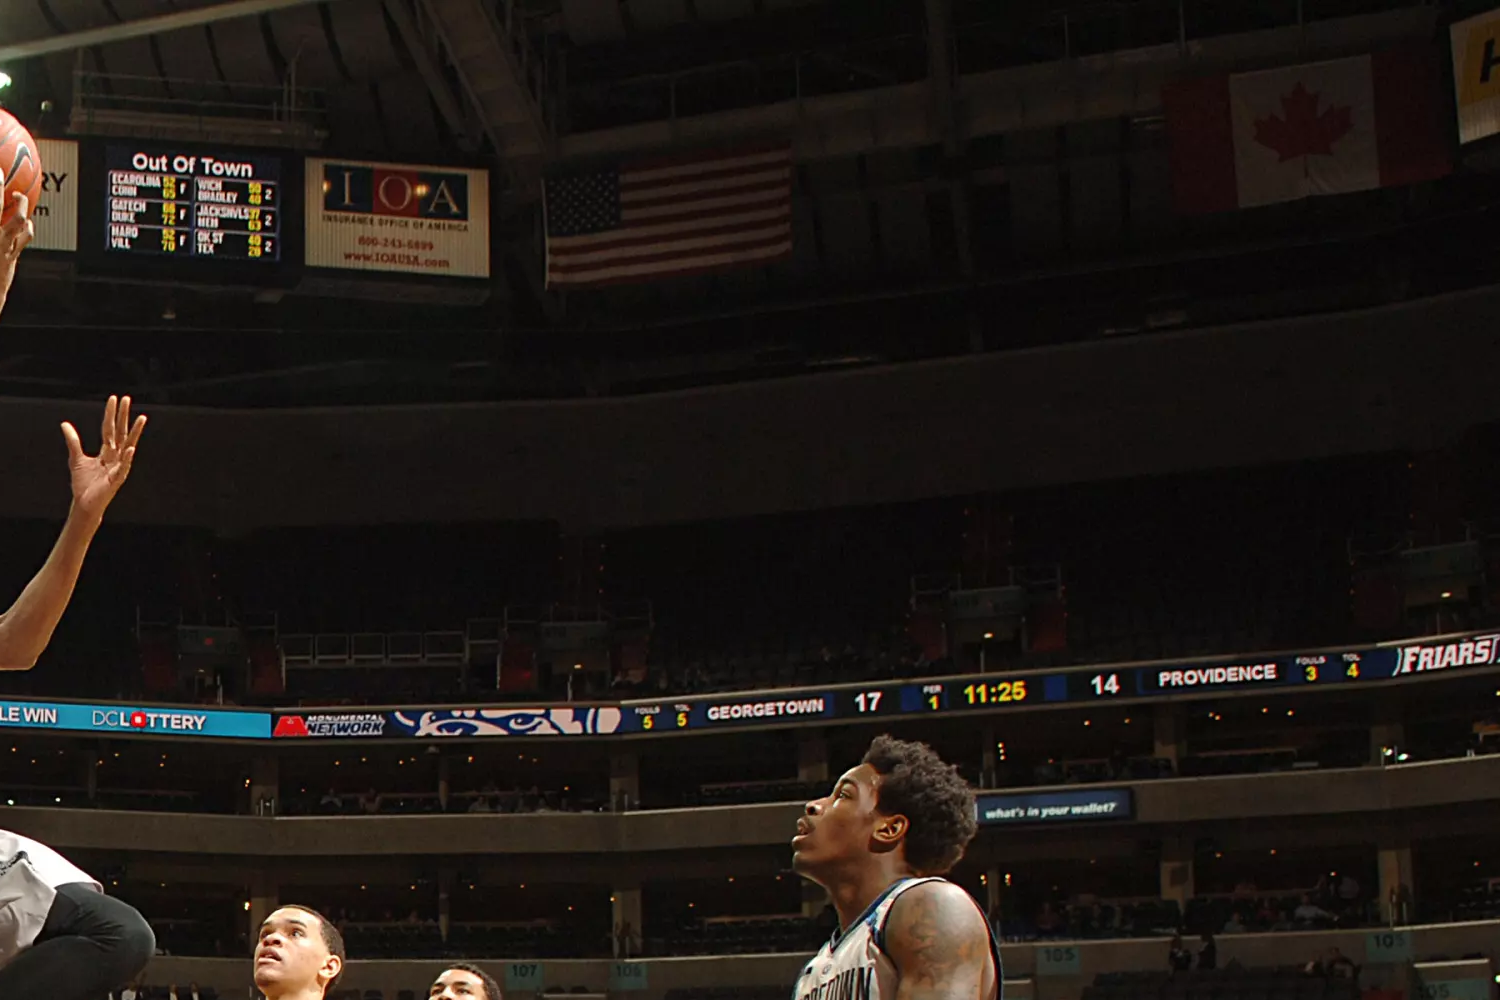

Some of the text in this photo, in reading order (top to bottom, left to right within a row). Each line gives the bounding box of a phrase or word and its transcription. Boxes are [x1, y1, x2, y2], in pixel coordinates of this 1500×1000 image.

[133, 153, 253, 178] Out Of Town
[265, 188, 273, 200] 2
[265, 214, 273, 227] 2
[378, 218, 409, 228] OFFICE
[413, 221, 424, 230] OF
[428, 222, 469, 232] AMERICA
[265, 240, 273, 253] 2
[1296, 656, 1327, 665] FOULS
[1401, 640, 1492, 673] FRIARS
[1159, 664, 1277, 687] PROVIDENCE
[1305, 663, 1360, 681] 3 4
[964, 681, 1027, 704] 11:25
[1091, 674, 1120, 695] 14
[707, 699, 825, 721] GEORGETOWN
[854, 692, 882, 712] 17
[928, 696, 939, 710] 1
[23, 708, 57, 723] WIN
[308, 714, 384, 722] MONUMENTAL
[643, 712, 687, 729] 5 5
[306, 721, 383, 736] NETWORK
[985, 802, 1118, 820] what's in your wallet?
[512, 964, 537, 977] 107
